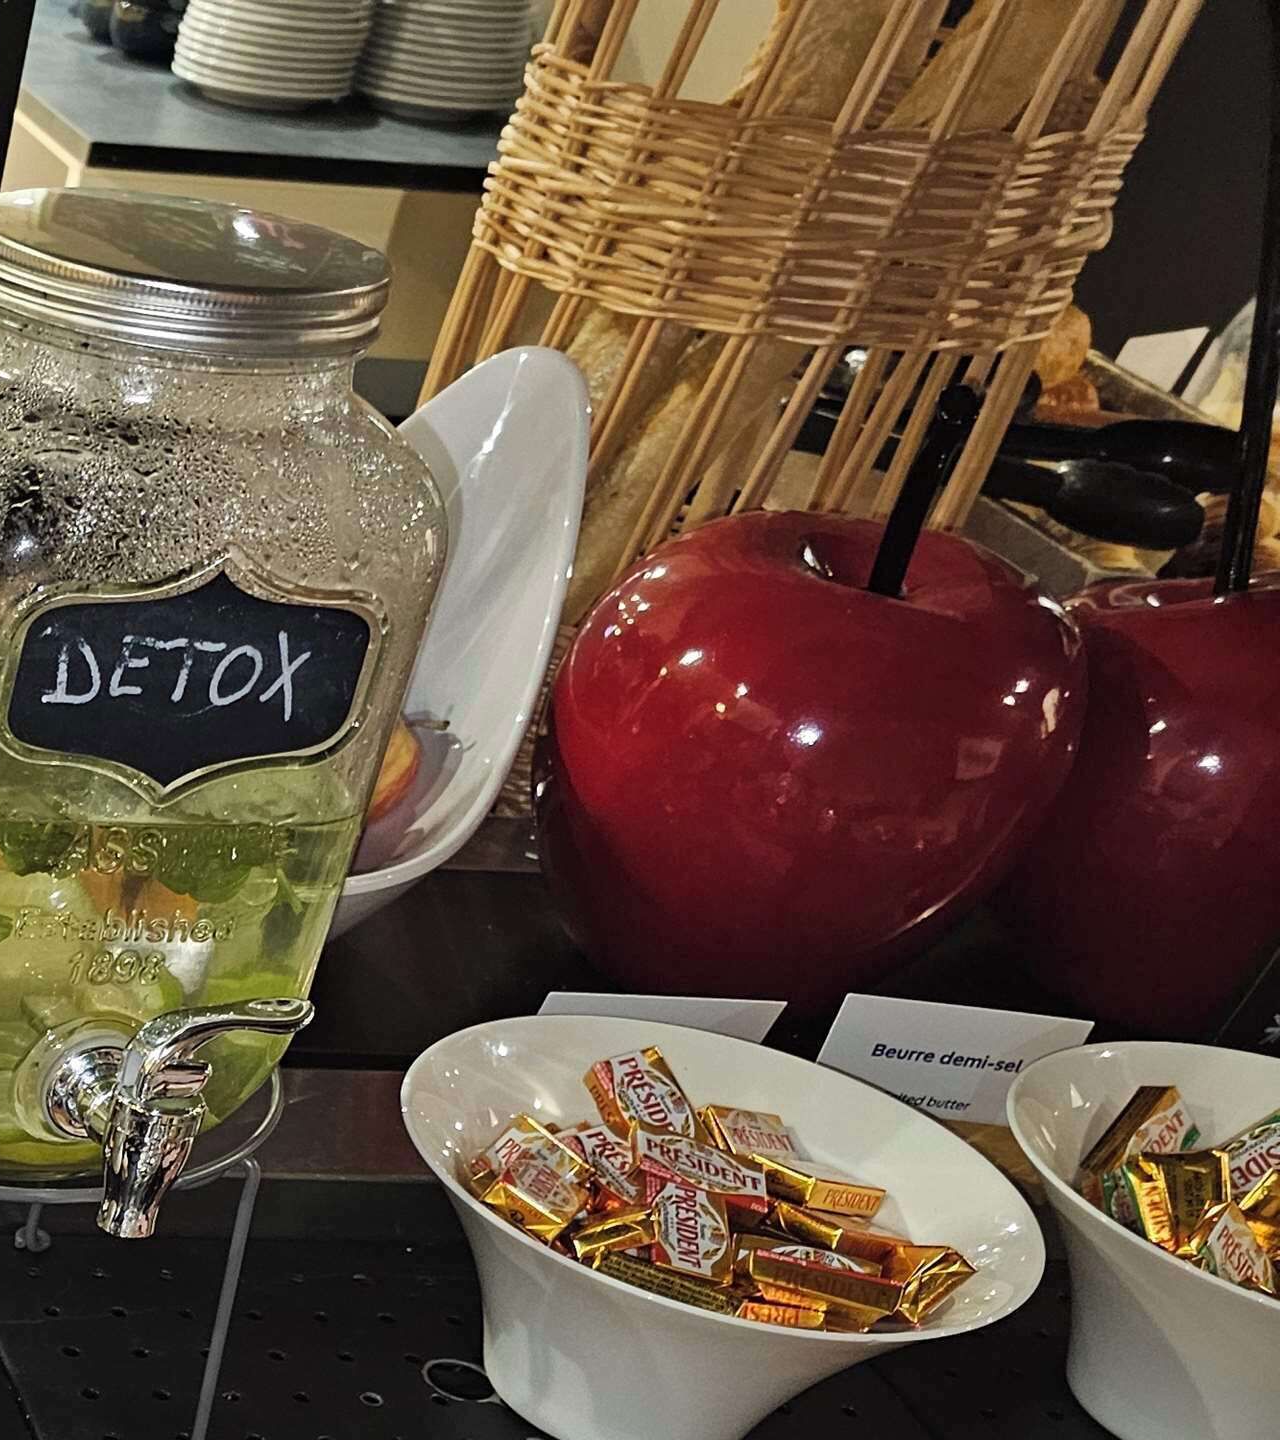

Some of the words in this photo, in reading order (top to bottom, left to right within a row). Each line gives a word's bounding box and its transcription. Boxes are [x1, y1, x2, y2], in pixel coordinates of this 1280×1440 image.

[40, 629, 313, 723] DETOX
[871, 1043, 936, 1064] Beurre
[939, 1051, 1024, 1074] demi-sel
[926, 1096, 972, 1112] butter
